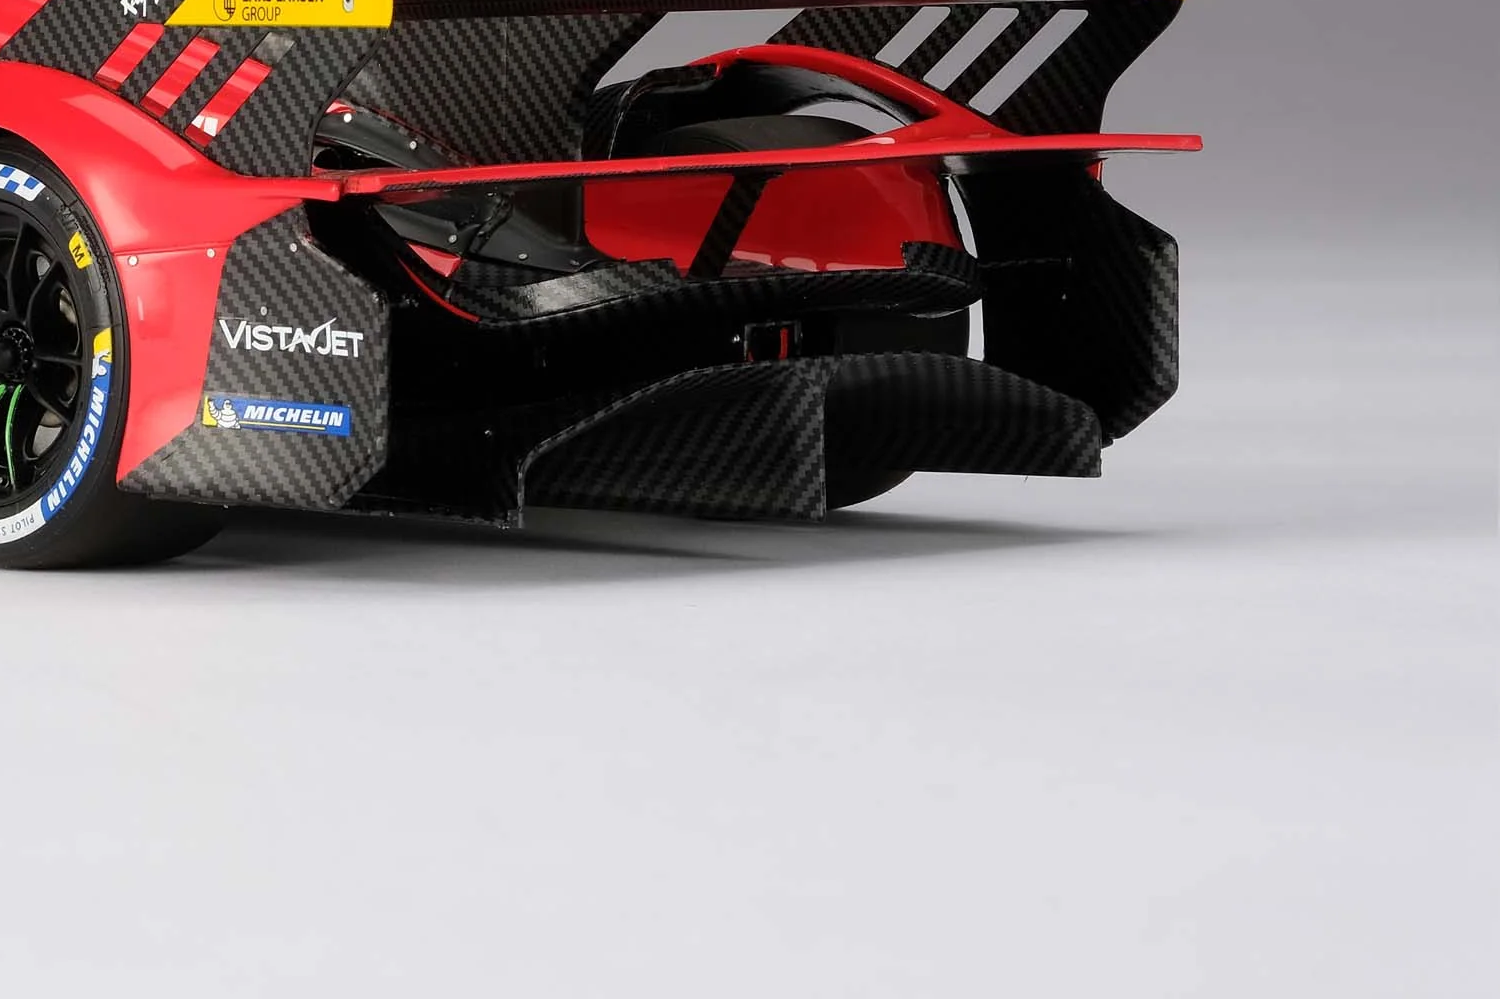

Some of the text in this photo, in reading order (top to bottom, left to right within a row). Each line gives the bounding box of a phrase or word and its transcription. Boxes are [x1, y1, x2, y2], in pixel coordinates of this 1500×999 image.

[242, 6, 281, 22] GROUP
[243, 405, 343, 427] MICHELIN
[47, 386, 105, 512] MICHELIN
[11, 513, 35, 530] PILOT
